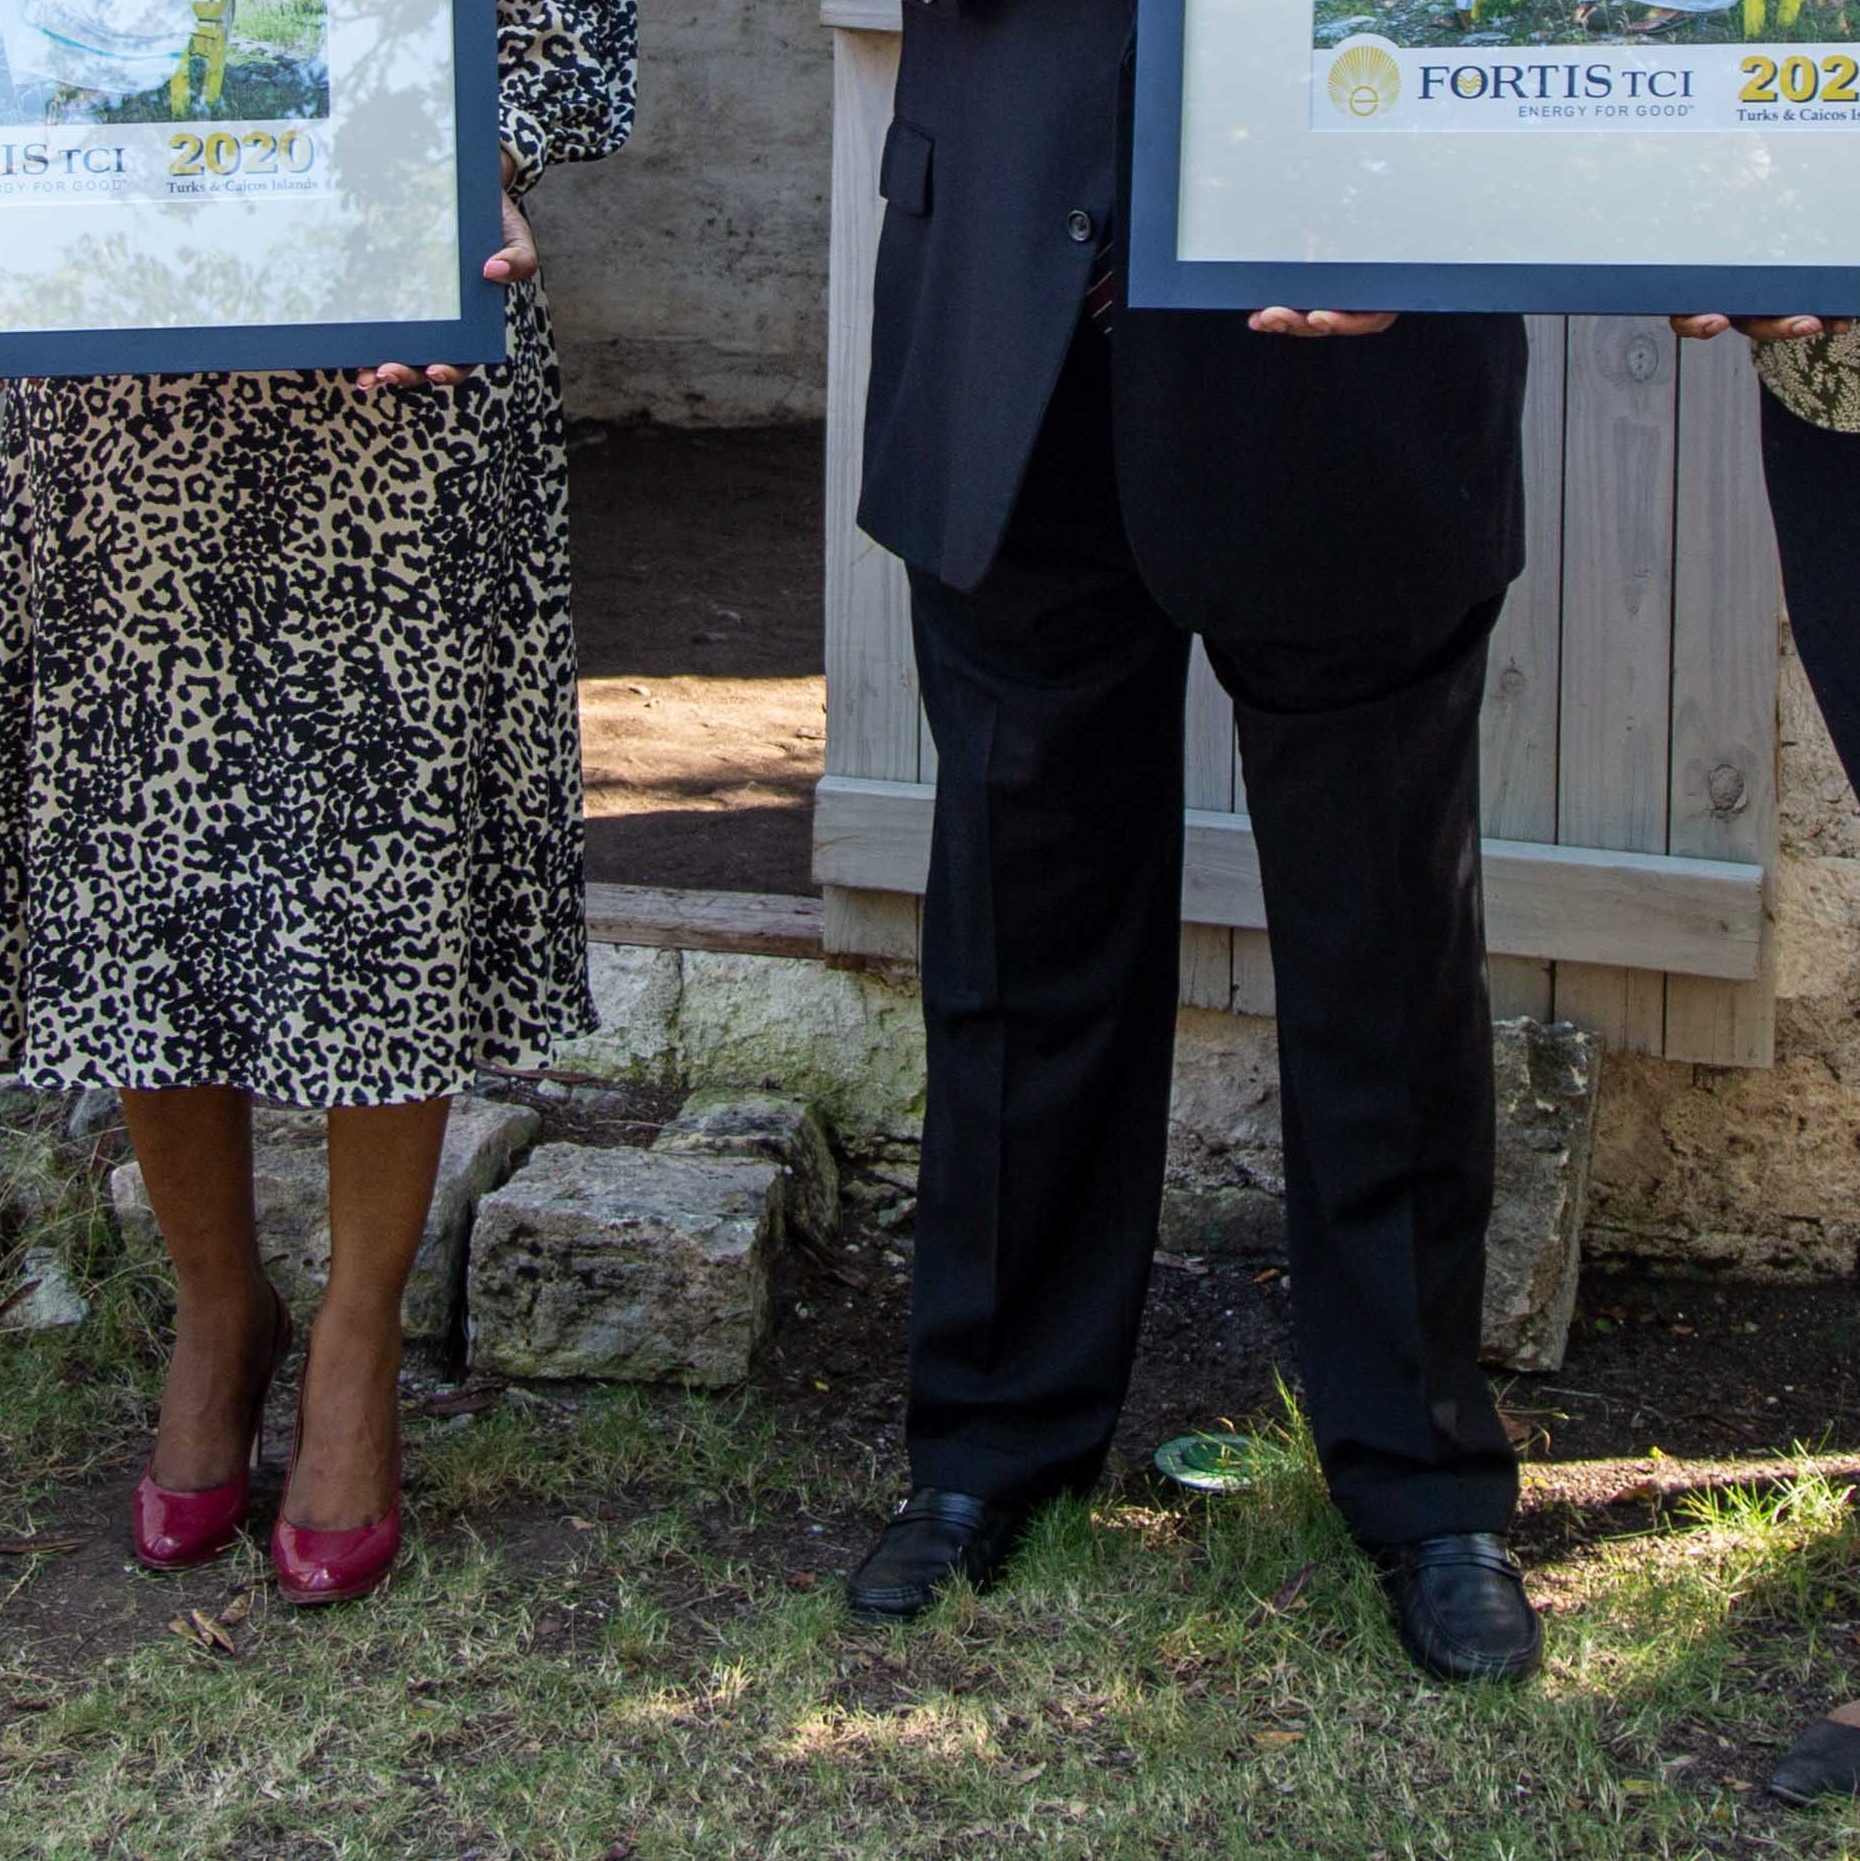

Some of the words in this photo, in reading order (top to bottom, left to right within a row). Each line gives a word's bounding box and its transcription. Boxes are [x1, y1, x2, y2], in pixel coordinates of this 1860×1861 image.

[1418, 64, 1613, 99] FORTIS
[1621, 70, 1695, 98] TCI
[1518, 105, 1587, 118] ENERGY
[1595, 105, 1629, 117] FOR
[1736, 108, 1779, 121] Turks
[1783, 108, 1795, 121] &
[1799, 107, 1847, 121] Caicos
[58, 147, 126, 174] TCI
[168, 129, 314, 177] 2020
[34, 180, 66, 193] FOR
[166, 181, 205, 193] Turks
[225, 179, 267, 192] Caicos
[272, 178, 319, 190] Islands
